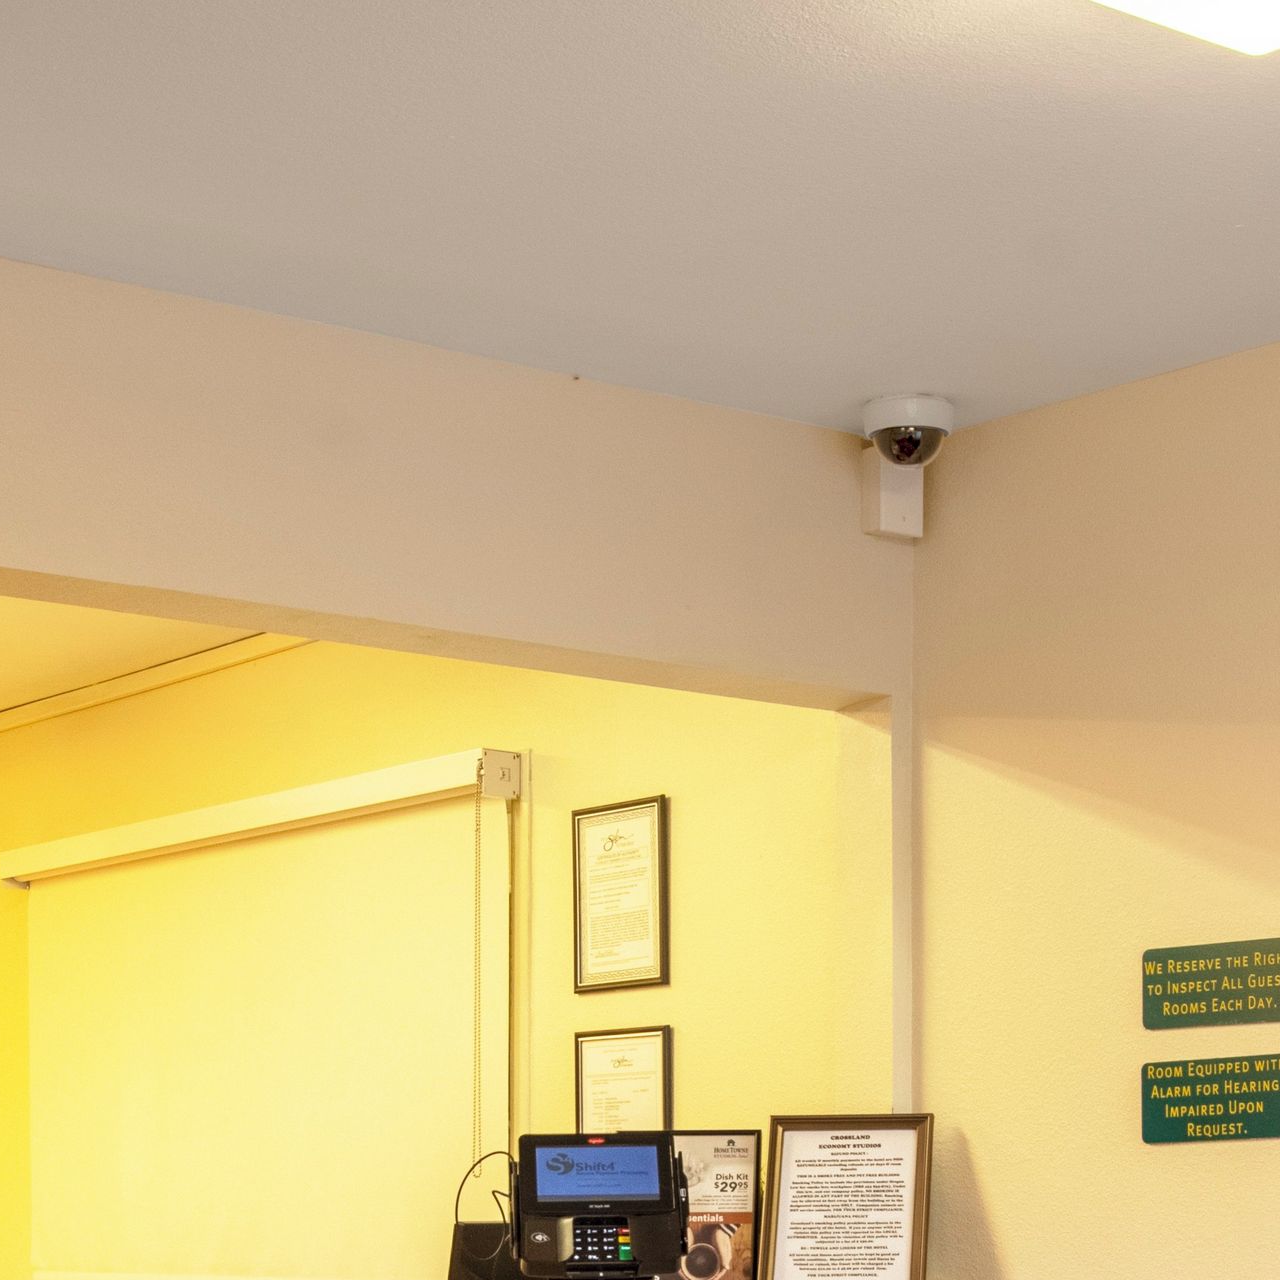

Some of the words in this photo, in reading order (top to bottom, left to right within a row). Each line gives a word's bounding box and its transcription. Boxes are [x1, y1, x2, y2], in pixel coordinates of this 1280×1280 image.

[1145, 961, 1163, 976] WE
[1168, 958, 1222, 973] RESERVE
[1227, 956, 1249, 968] THE
[1147, 984, 1162, 996] TO
[1168, 980, 1217, 994] INSPECT
[1222, 976, 1243, 990] ALL
[1163, 1002, 1207, 1016] ROOMS
[1212, 998, 1243, 1012] EACH
[1248, 996, 1277, 1010] DAY.
[1147, 1066, 1183, 1079] ROOM
[1188, 1061, 1249, 1077] EQUIPPED
[1151, 1085, 1191, 1099] ALARM
[1197, 1082, 1219, 1095] FOR
[1224, 1079, 1280, 1094] HEARING
[1165, 1103, 1224, 1118] IMPAIRED
[1229, 1101, 1264, 1115] UPON
[1187, 1123, 1248, 1138] REQUEST.
[575, 1162, 615, 1172] Shift4
